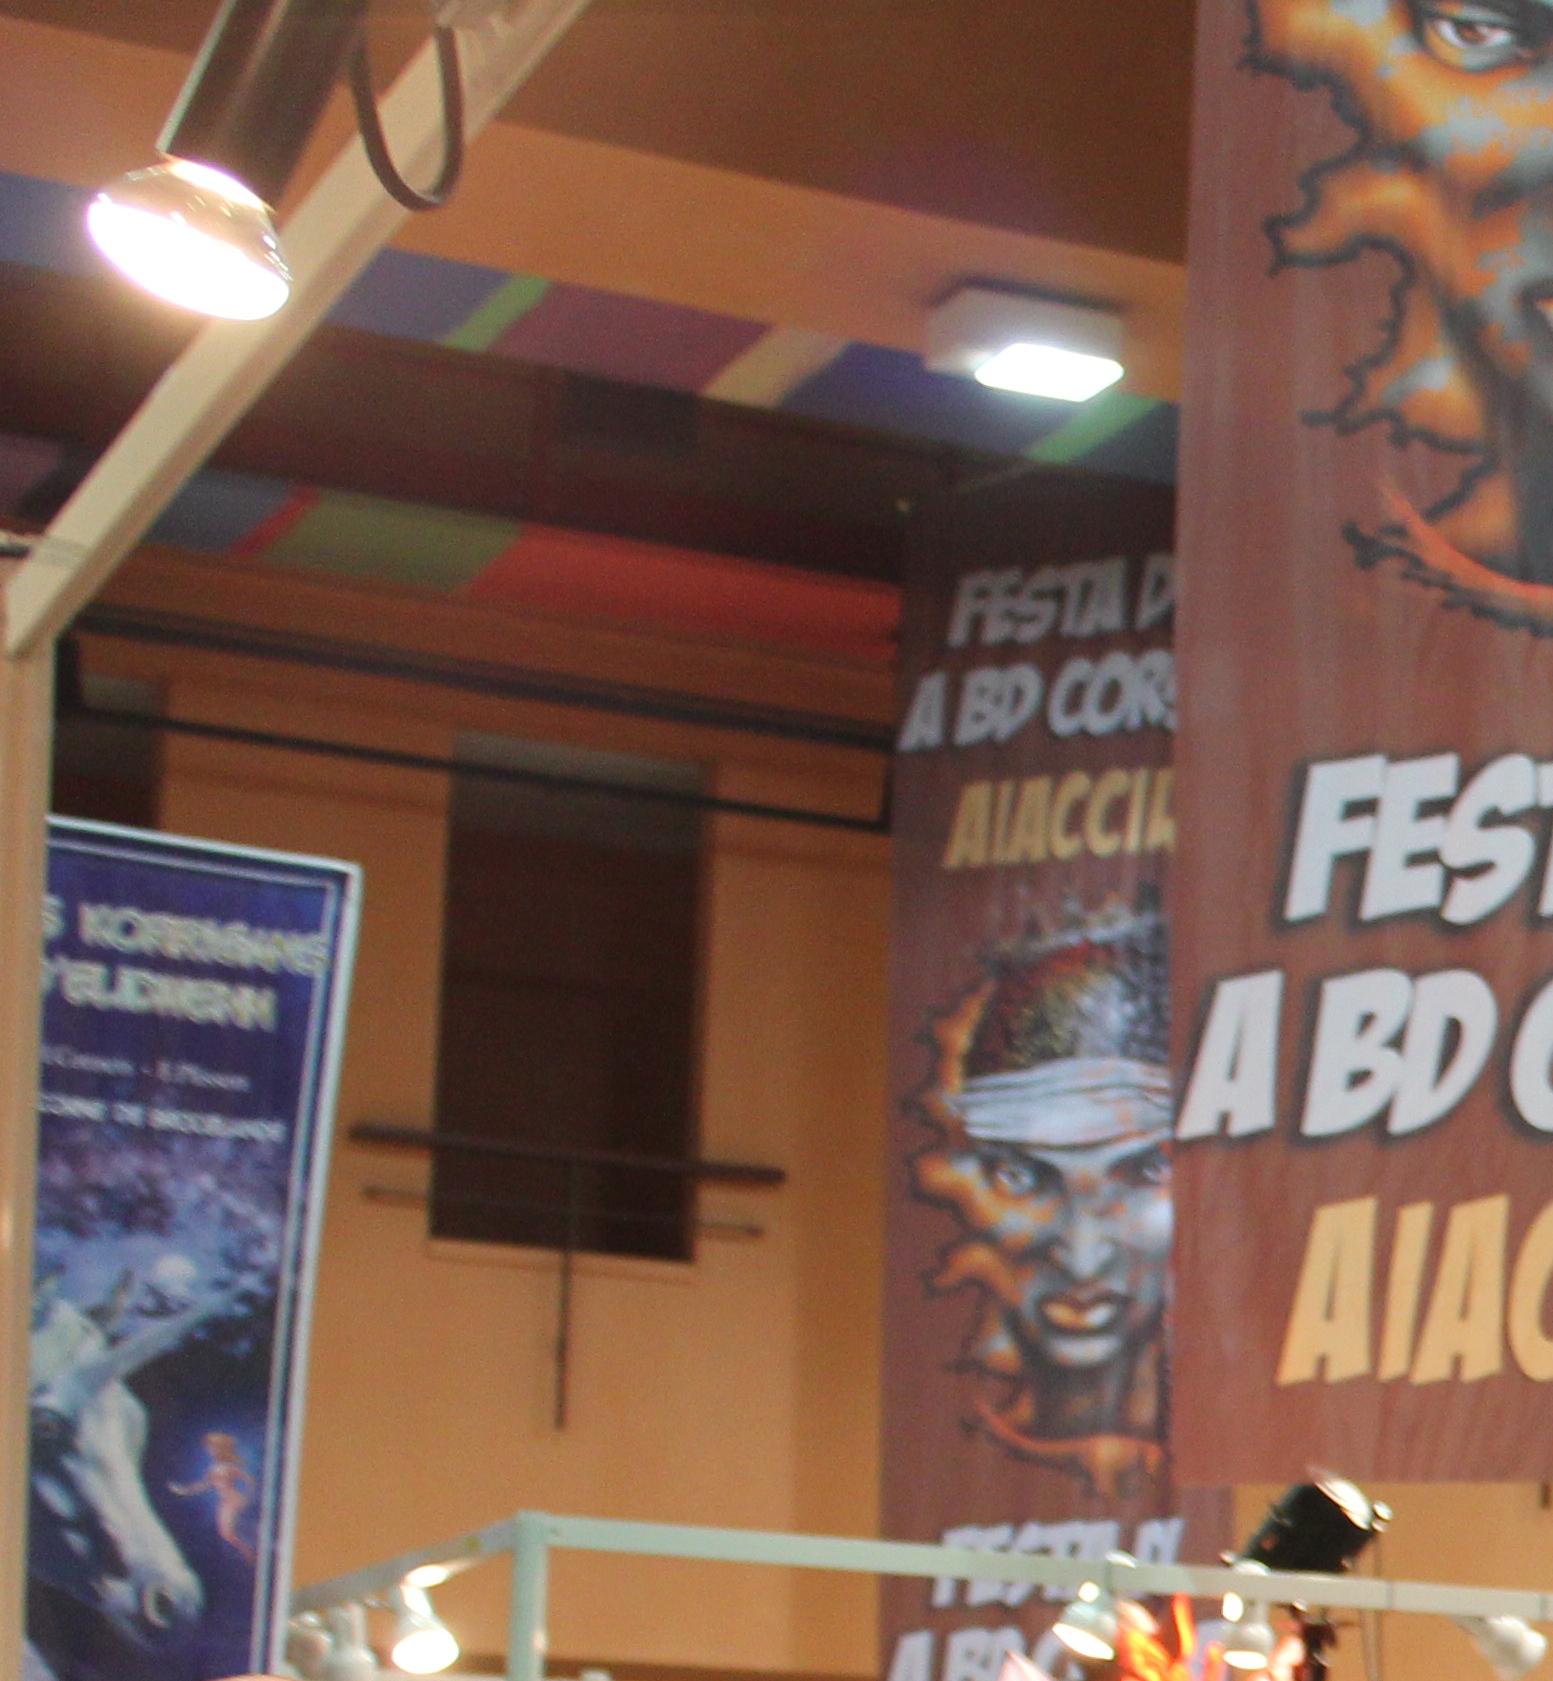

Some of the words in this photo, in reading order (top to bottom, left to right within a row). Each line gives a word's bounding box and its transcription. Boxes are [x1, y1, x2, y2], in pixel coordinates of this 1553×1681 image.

[948, 556, 1127, 647] FESTA
[1136, 554, 1176, 630] D
[897, 671, 946, 751] A
[954, 664, 1043, 745] BD
[1049, 650, 1177, 738] COR
[1175, 971, 1284, 1140] A
[1301, 967, 1497, 1137] BD
[932, 1519, 1120, 1608] FESTA
